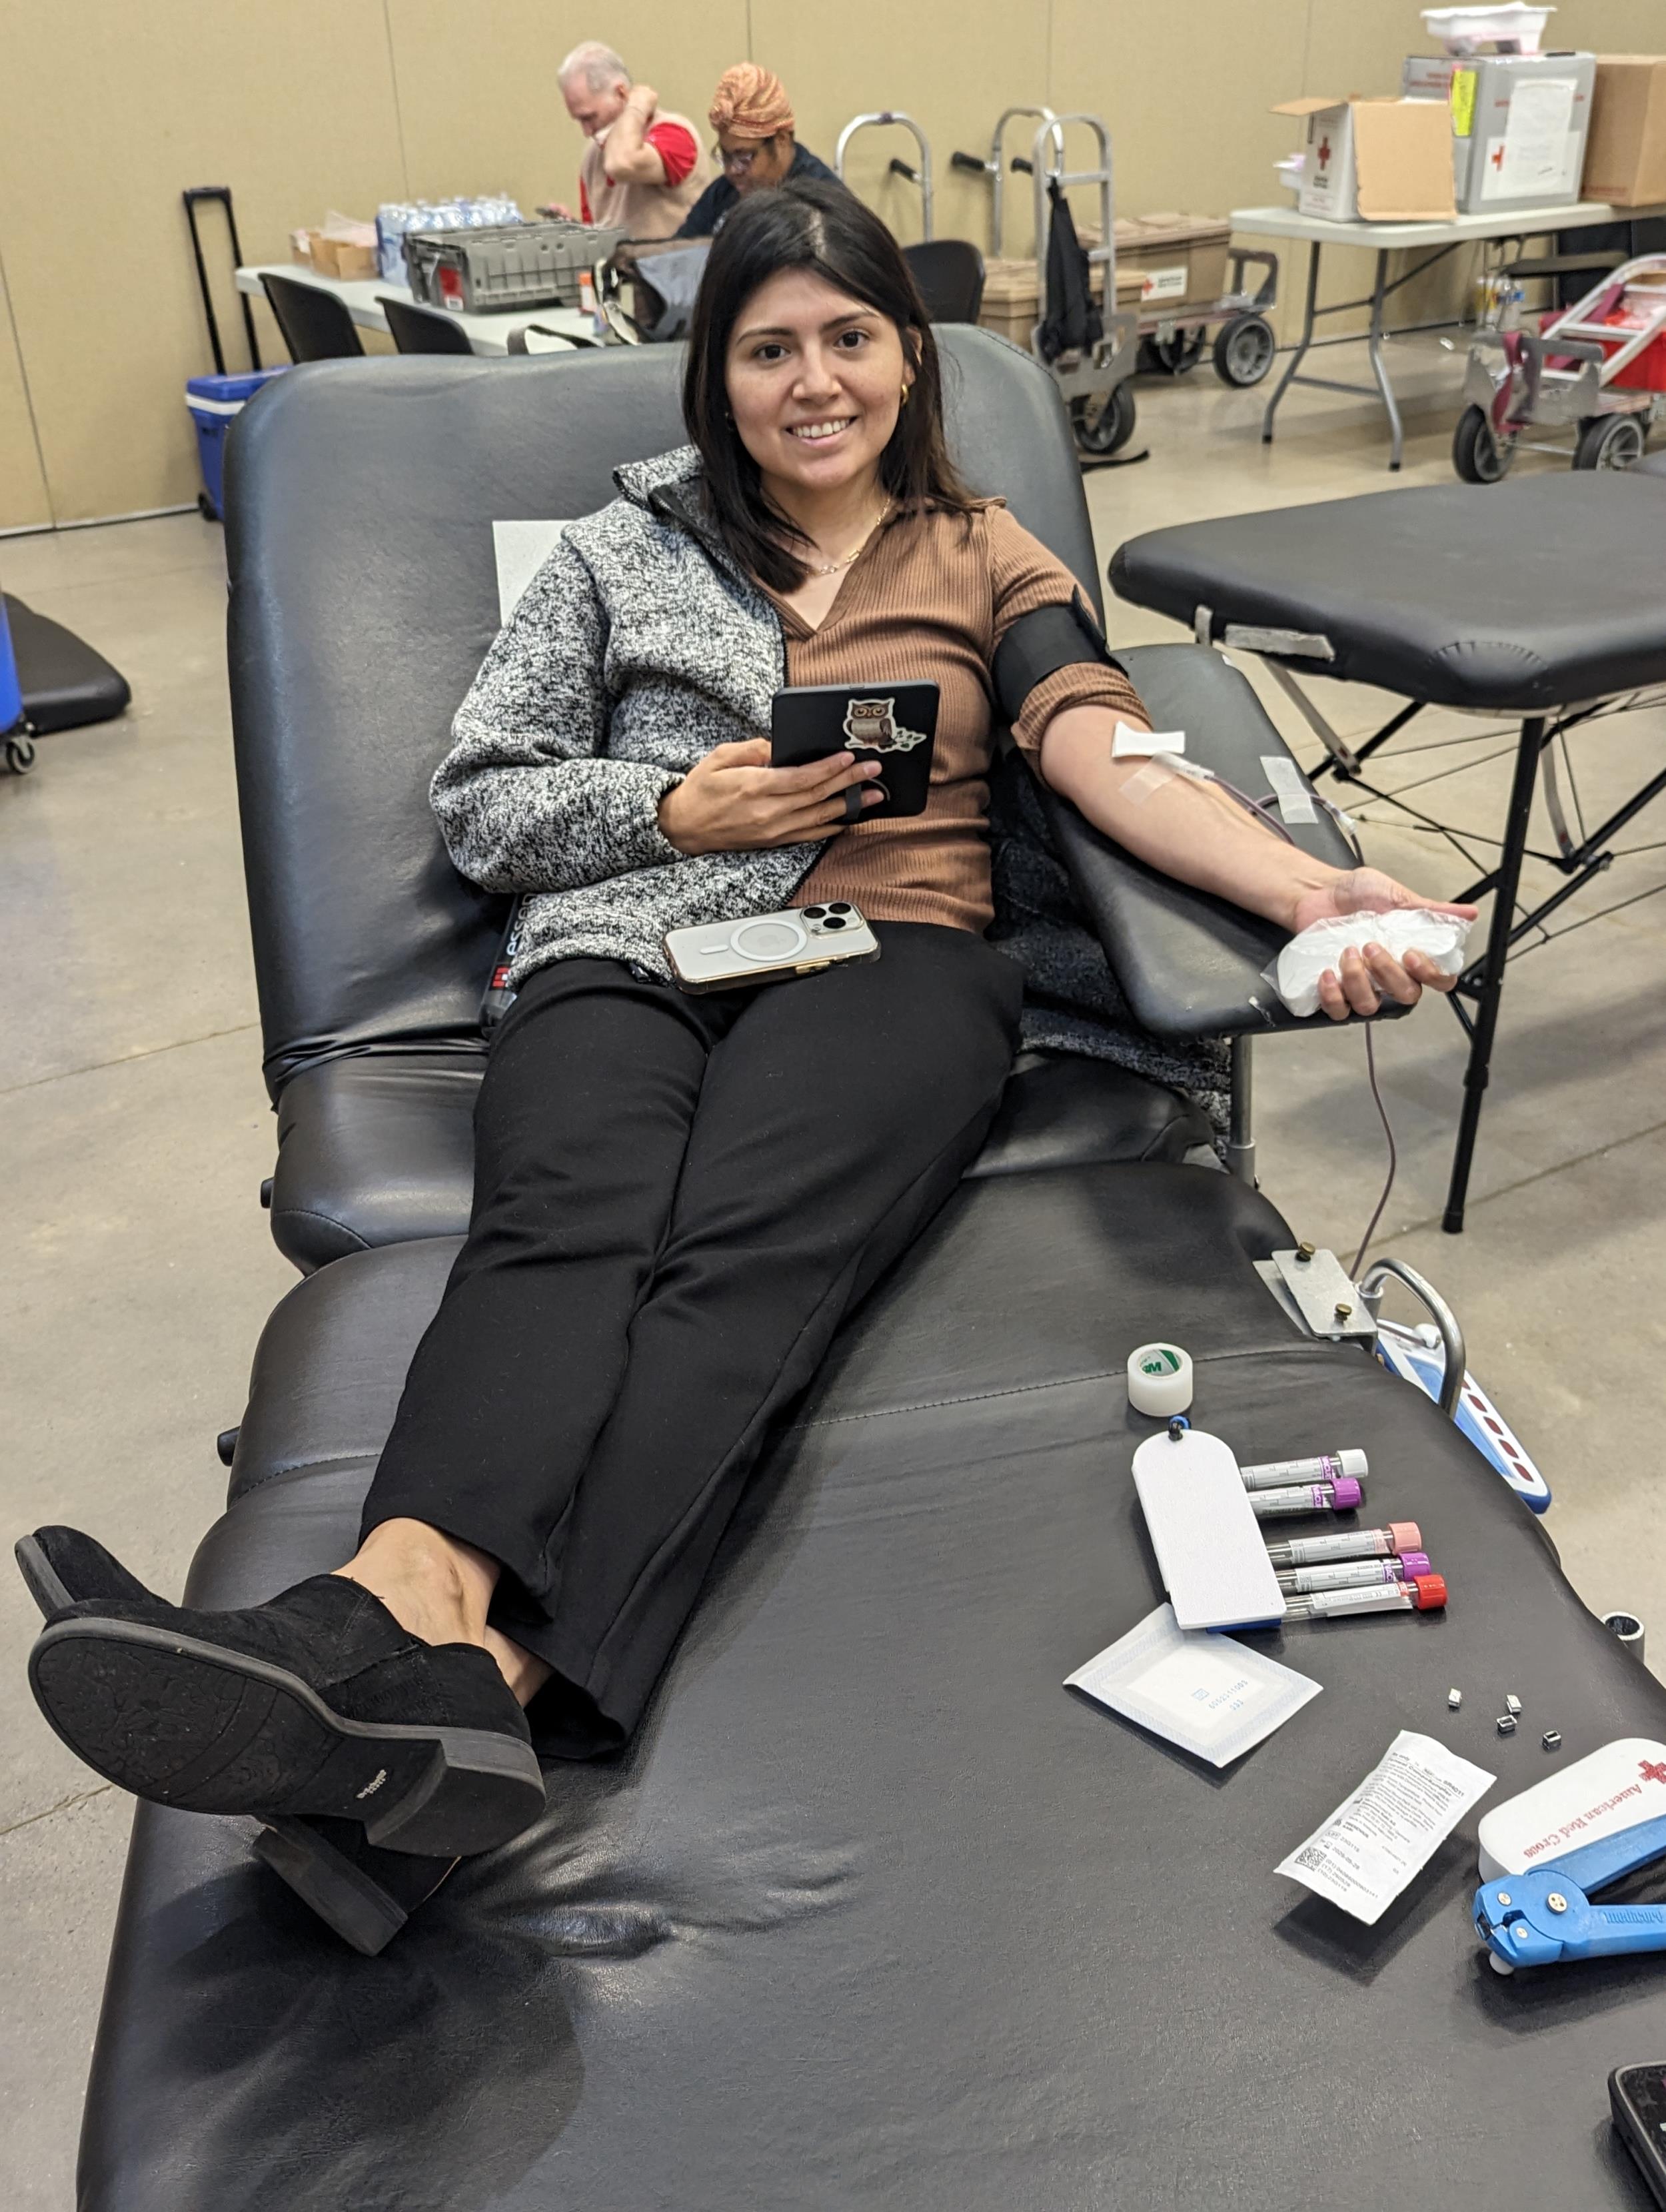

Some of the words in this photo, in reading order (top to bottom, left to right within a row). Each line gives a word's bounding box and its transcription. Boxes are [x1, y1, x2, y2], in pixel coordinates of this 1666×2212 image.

[1585, 1784, 1643, 1820] American
[1557, 1816, 1587, 1839] Red
[1523, 1834, 1561, 1860] Cross
